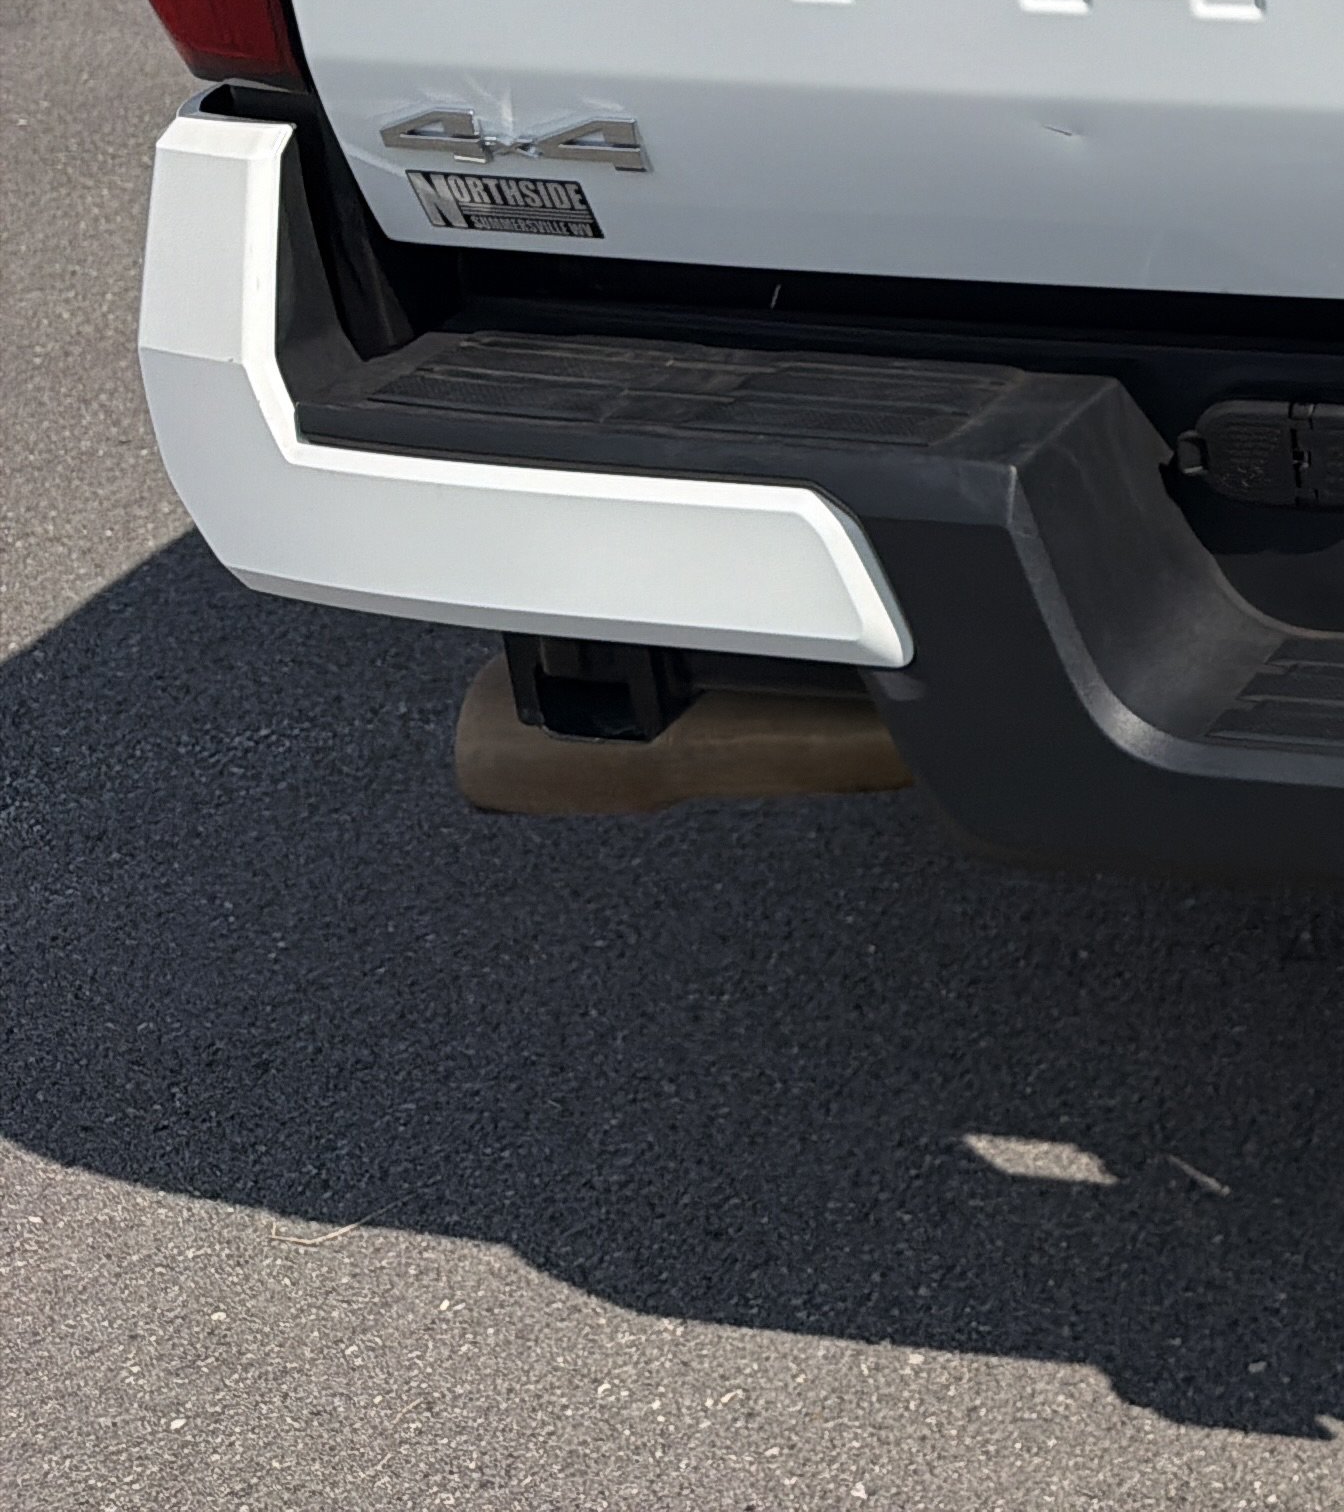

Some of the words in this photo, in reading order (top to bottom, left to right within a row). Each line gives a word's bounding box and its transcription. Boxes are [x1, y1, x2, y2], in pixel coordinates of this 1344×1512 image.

[406, 170, 588, 228] NORTHSIDE
[473, 214, 568, 235] SUMMERSVILLE
[570, 221, 594, 237] WV
